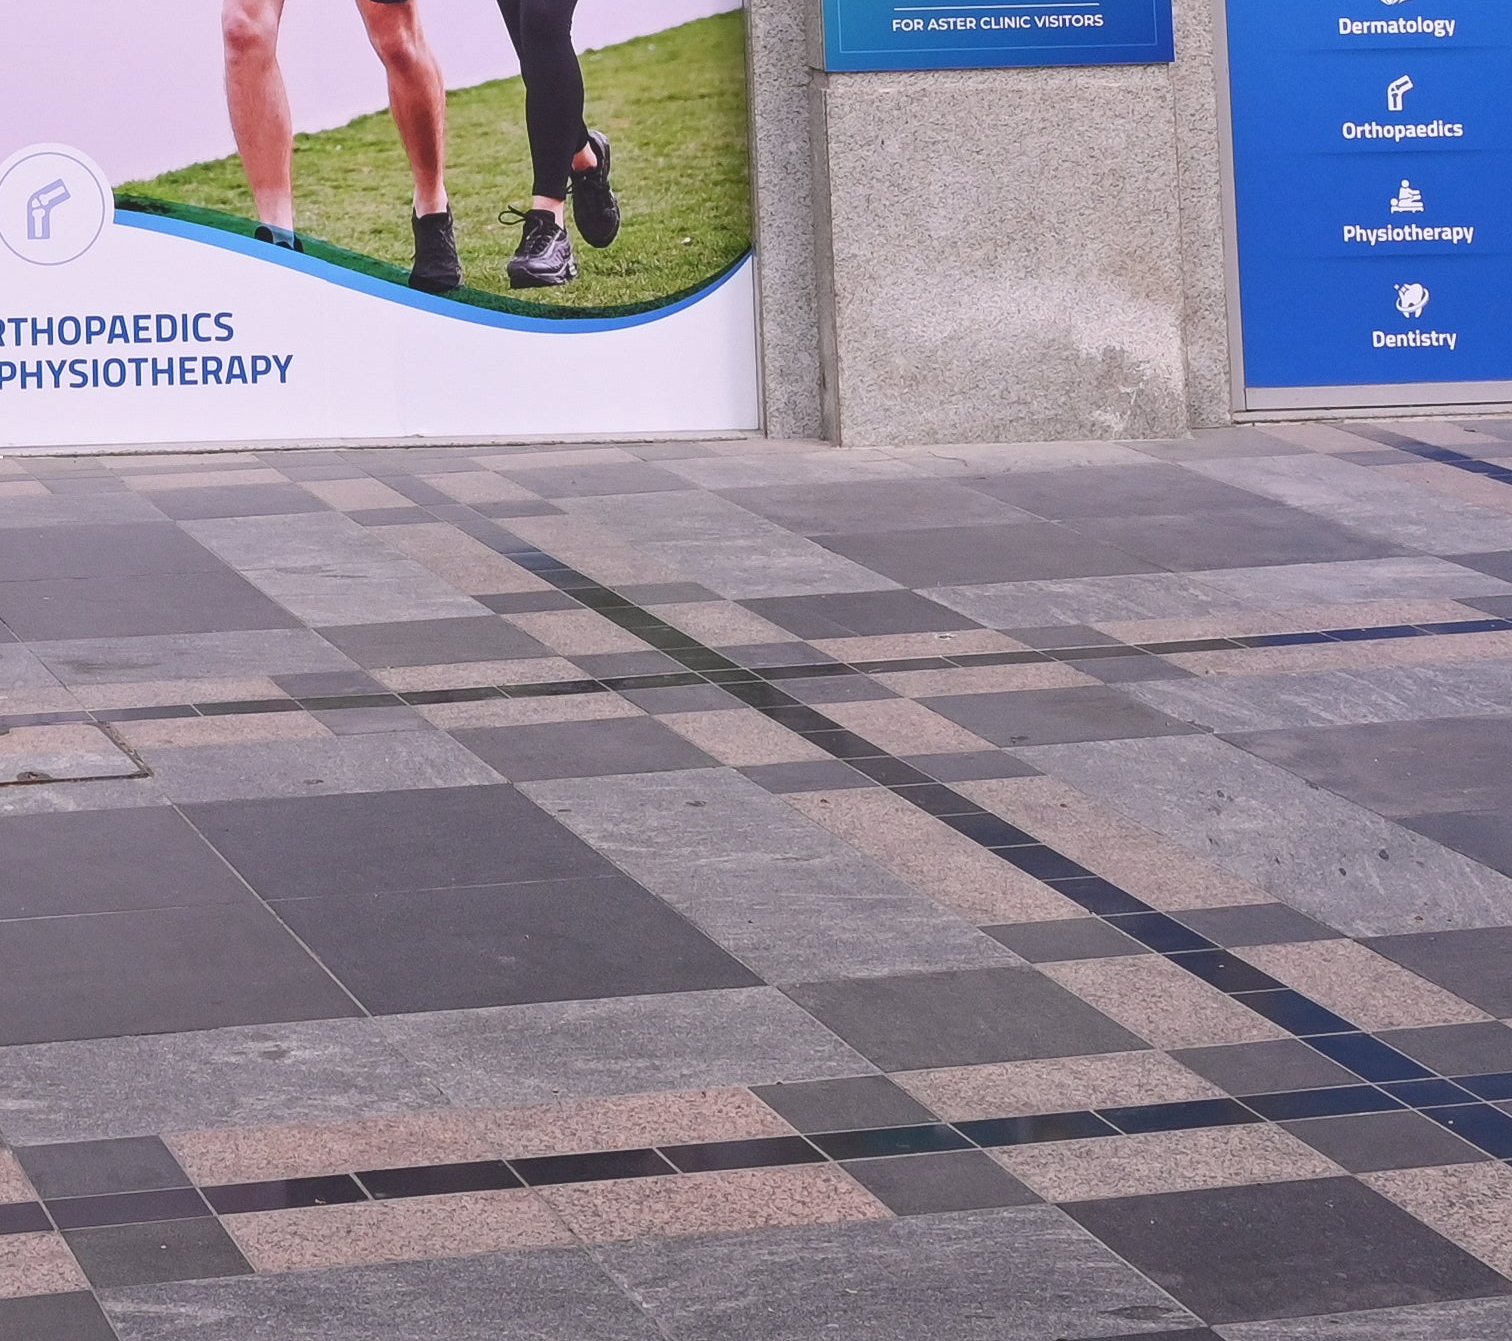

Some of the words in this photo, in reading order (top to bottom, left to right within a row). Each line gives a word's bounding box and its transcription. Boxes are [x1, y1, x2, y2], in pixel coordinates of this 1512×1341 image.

[892, 17, 924, 32] FOR
[927, 17, 977, 31] ASTER
[980, 15, 1031, 30] CLINIC
[1034, 13, 1104, 28] VISITORS
[1338, 16, 1456, 37] Dermatology
[1342, 120, 1464, 142] Orthopaedics
[1343, 224, 1474, 246] Physiotherapy
[1372, 329, 1457, 350] Dentistry
